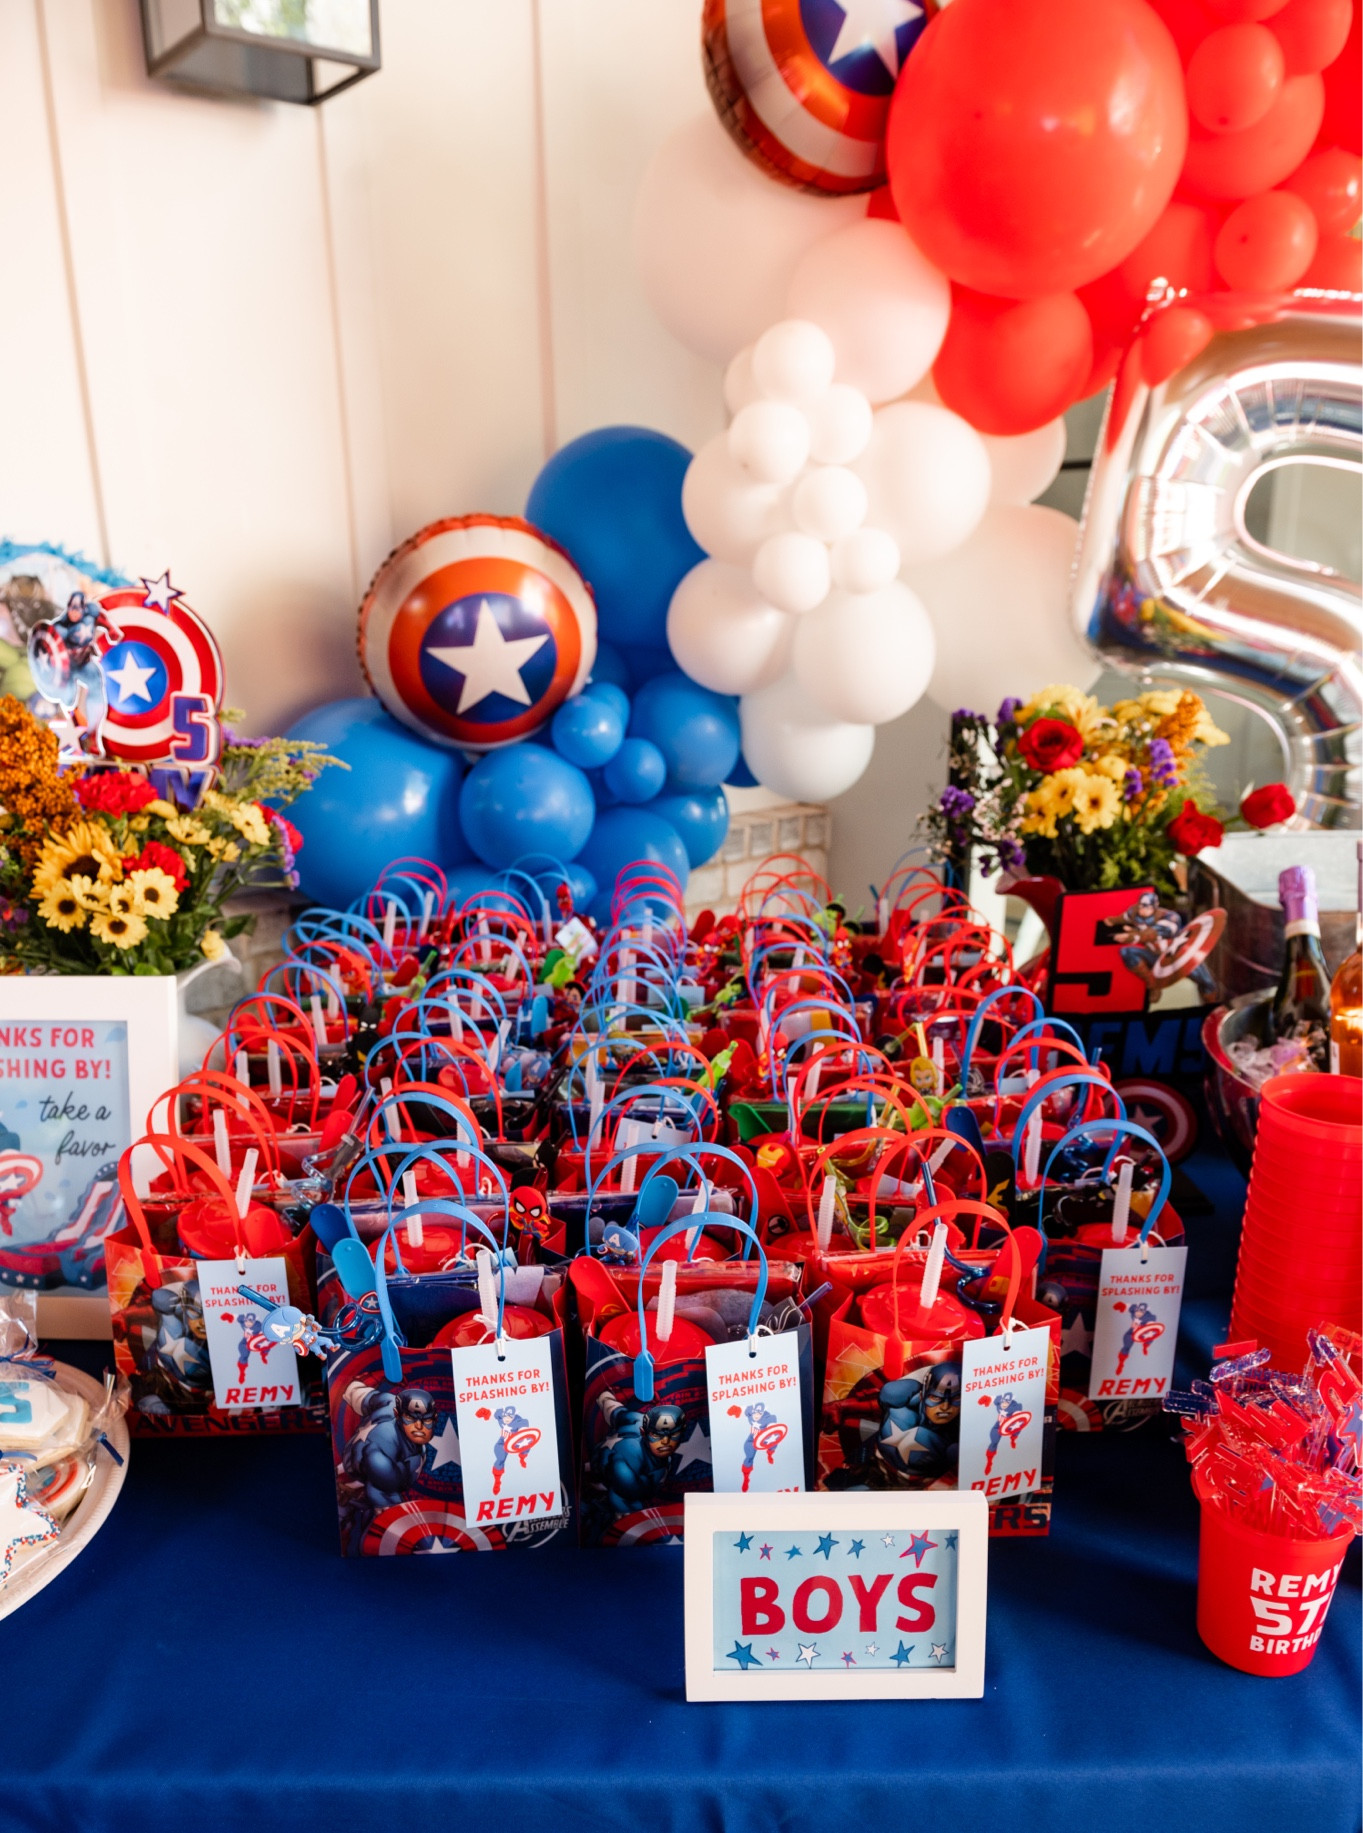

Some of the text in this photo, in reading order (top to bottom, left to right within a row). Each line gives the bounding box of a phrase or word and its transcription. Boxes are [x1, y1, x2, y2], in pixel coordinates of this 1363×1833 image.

[171, 693, 211, 764] 5
[1052, 886, 1155, 1013] 5
[51, 1027, 95, 1048] FOR
[75, 1059, 111, 1079] BY!
[39, 1090, 112, 1122] take a
[55, 1129, 116, 1165] favor
[256, 1284, 277, 1293] FOR
[1109, 1273, 1175, 1284] THANKS FOR
[1101, 1285, 1180, 1297] SPLASHING BY!
[718, 1364, 788, 1385] THANKS FOR
[973, 1357, 1038, 1377] THANKS FOR
[465, 1372, 514, 1387] THANKS
[518, 1369, 540, 1381] FOR
[965, 1368, 1044, 1393] SPLASHING BY!
[1097, 1377, 1167, 1396] REMY
[225, 1385, 294, 1404] REMY
[459, 1381, 550, 1403] SPLASHING BY!
[711, 1381, 776, 1402] SPLASHING
[779, 1377, 797, 1389] BY!
[476, 1491, 555, 1521] REMY
[740, 1572, 939, 1636] BOYS
